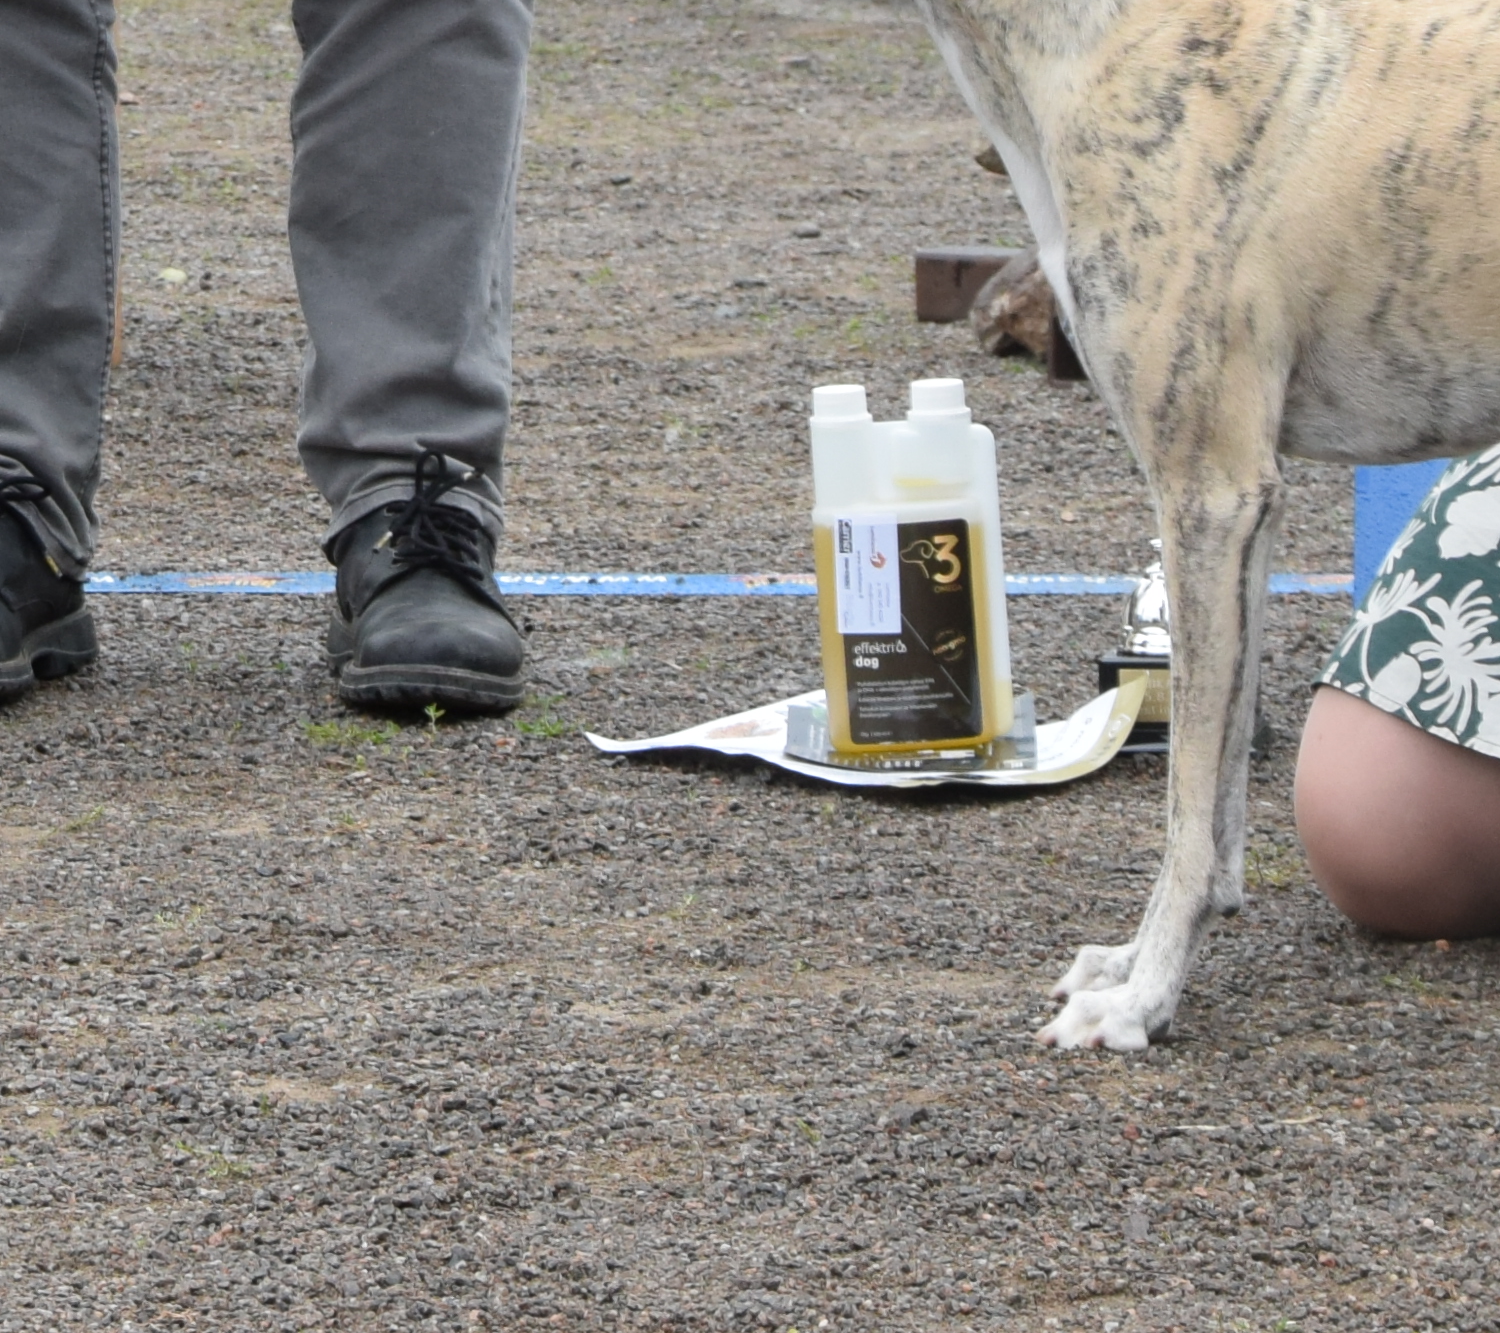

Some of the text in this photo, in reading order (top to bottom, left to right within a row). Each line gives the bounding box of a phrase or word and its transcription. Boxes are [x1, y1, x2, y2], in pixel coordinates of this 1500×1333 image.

[932, 534, 962, 583] 3
[933, 584, 963, 594] OMEGA
[853, 641, 894, 655] effektri
[854, 655, 880, 670] dog
